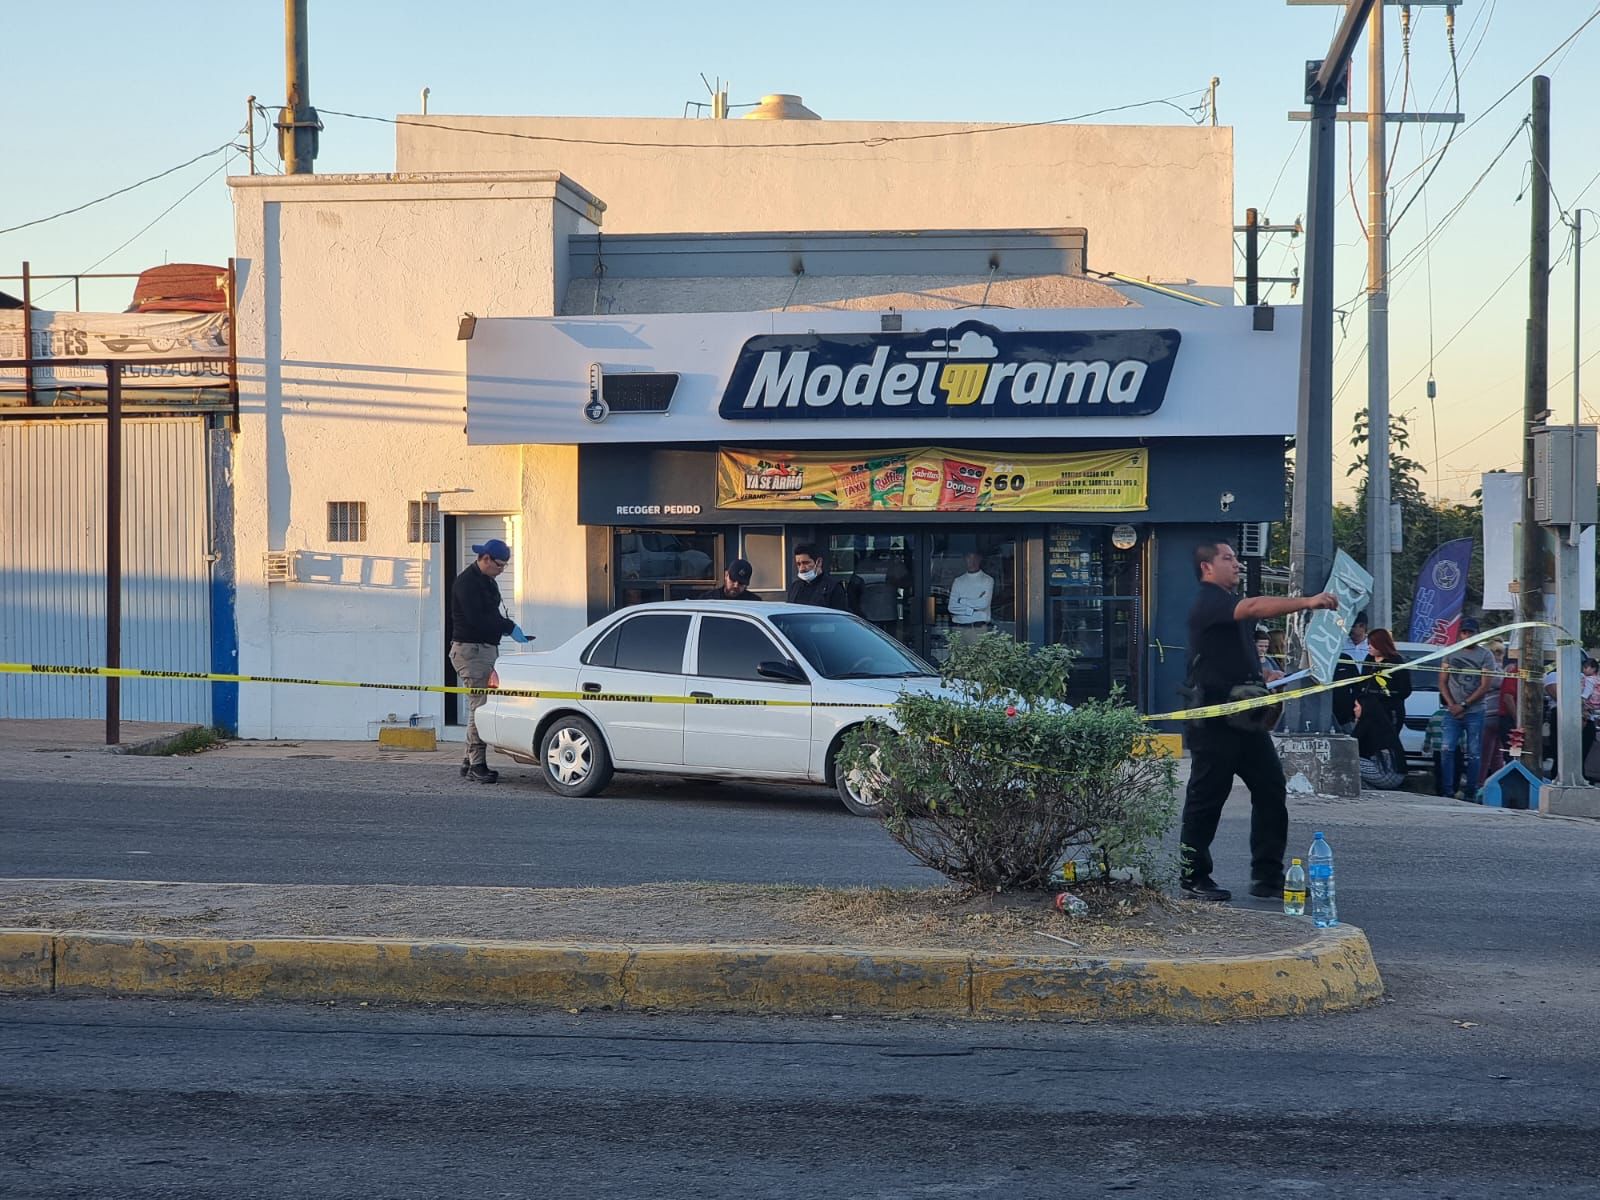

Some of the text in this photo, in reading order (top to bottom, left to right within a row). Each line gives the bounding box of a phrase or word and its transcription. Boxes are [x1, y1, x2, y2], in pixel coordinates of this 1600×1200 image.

[873, 470, 904, 491] Ruffles
[912, 468, 941, 481] Sabritas
[946, 479, 977, 494] Doritos
[984, 474, 1025, 491] $60
[616, 505, 701, 515] RECOGER PEDIDO
